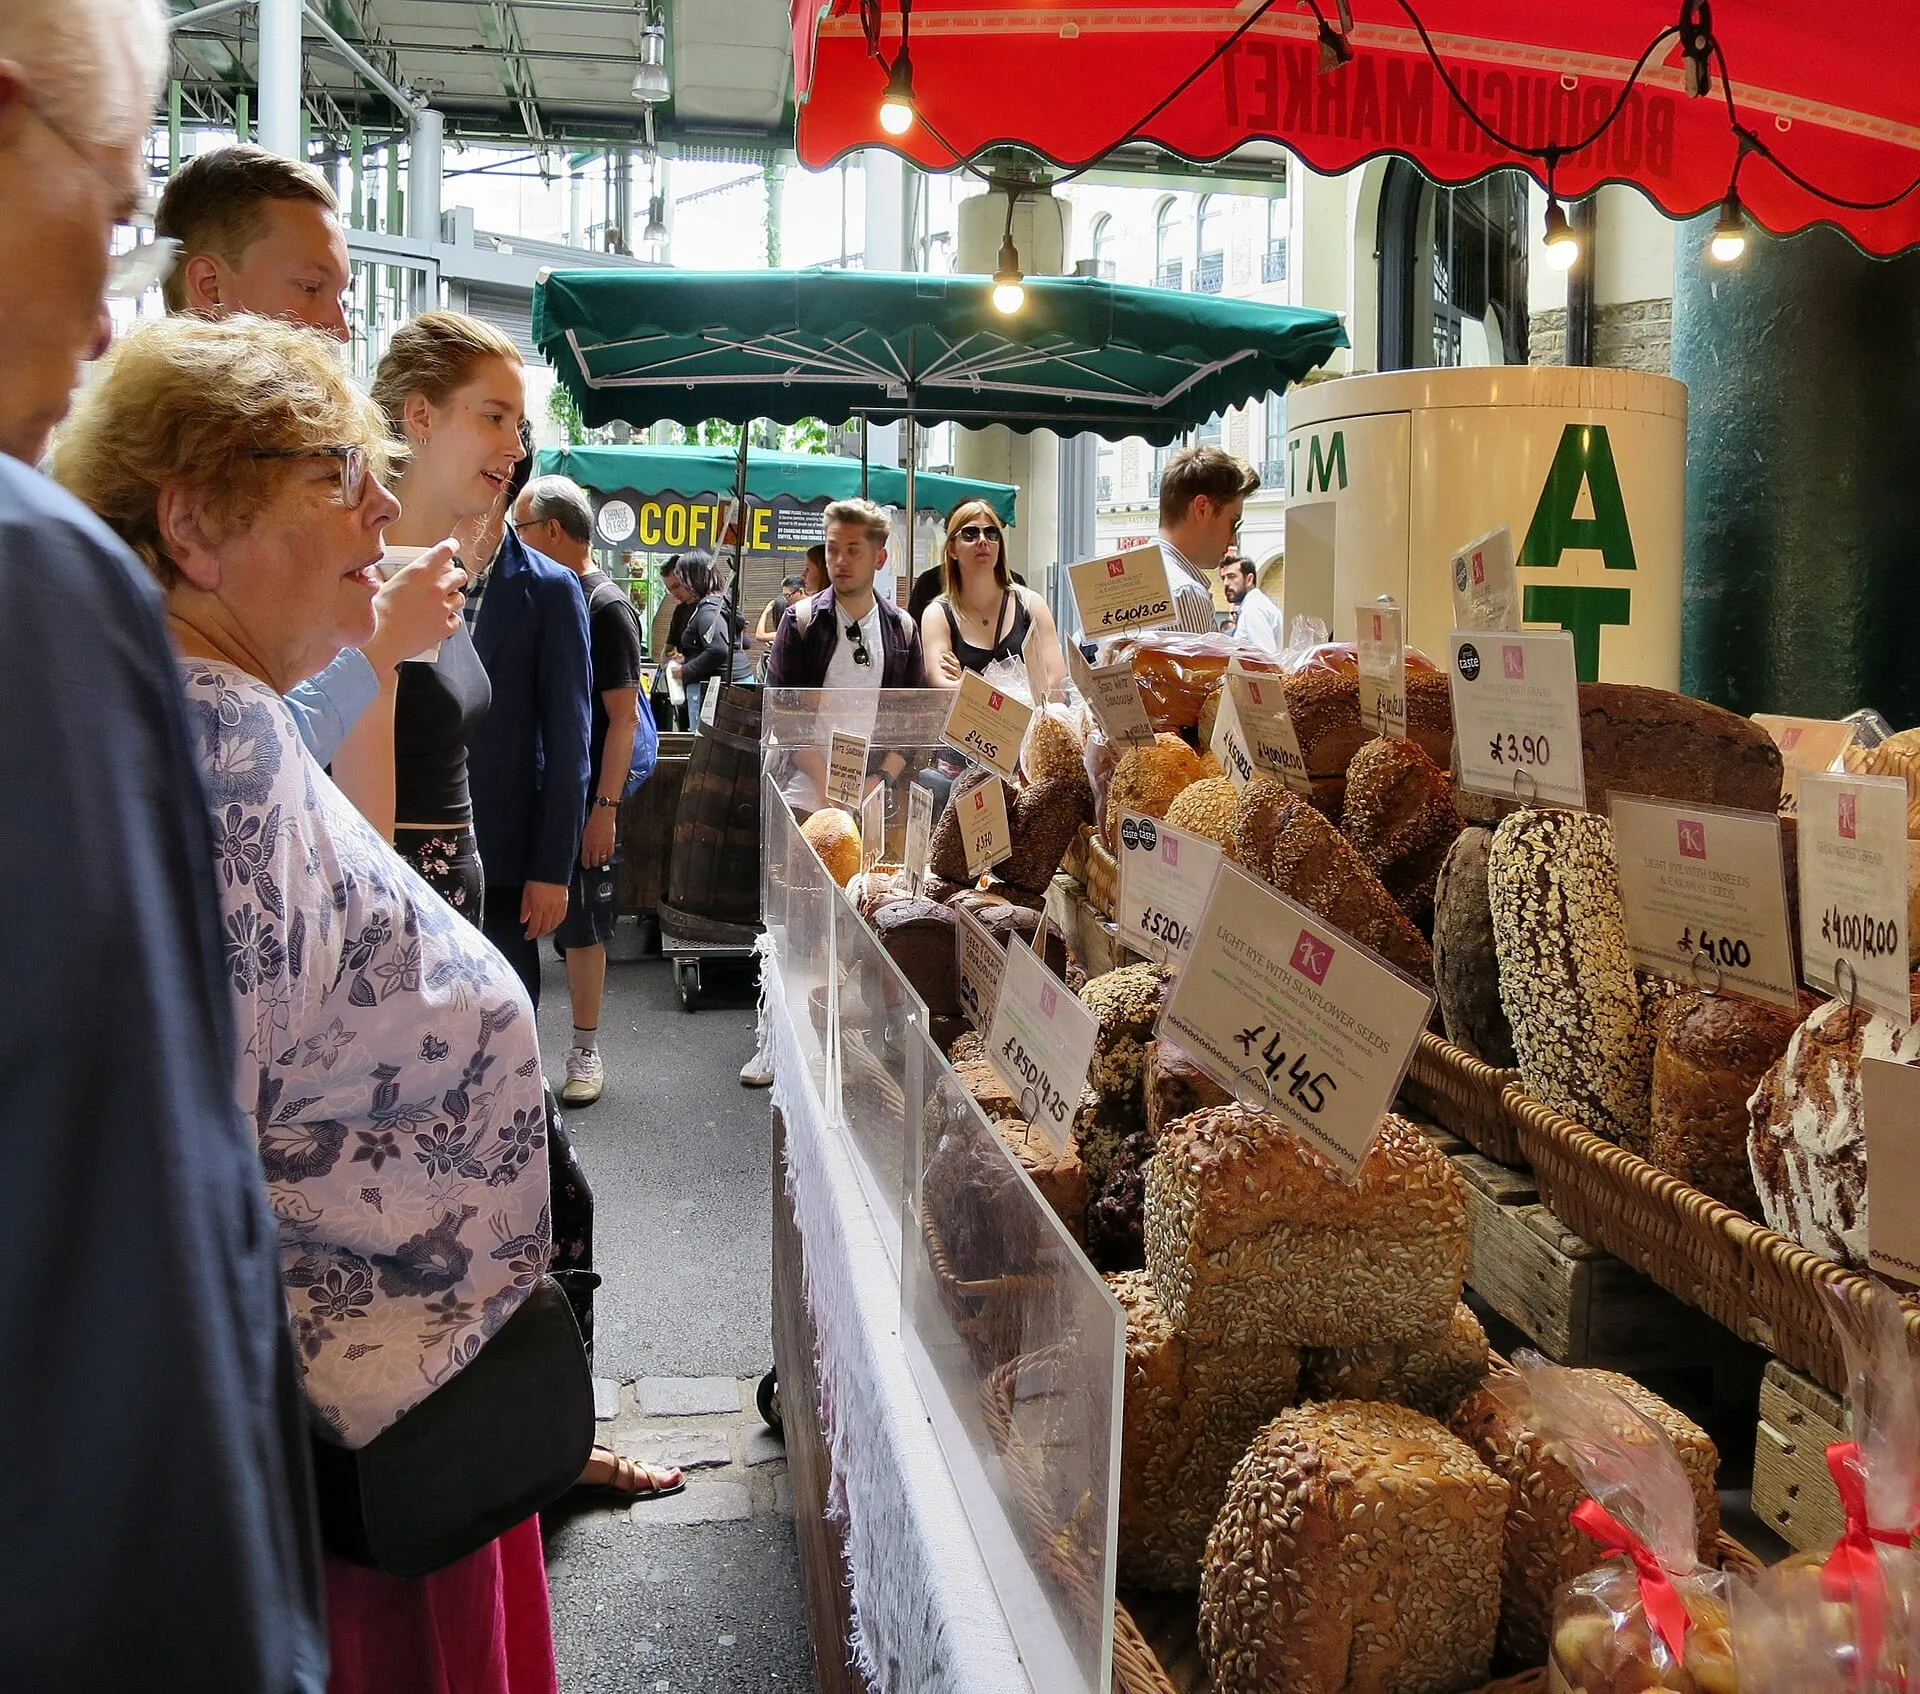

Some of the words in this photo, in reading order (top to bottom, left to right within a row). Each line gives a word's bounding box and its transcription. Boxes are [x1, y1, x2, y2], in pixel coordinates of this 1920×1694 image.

[639, 502, 772, 550] COFE
[1460, 658, 1479, 669] taste
[1490, 732, 1550, 767] £3.90
[1122, 829, 1138, 840] taste
[1139, 829, 1156, 842] taste
[1216, 926, 1247, 952] LIGHT
[1248, 946, 1271, 968] RYE
[1265, 956, 1293, 985] WITH
[1293, 978, 1355, 1029] SUNFLOWER
[1354, 1023, 1392, 1055] SEEDS
[1233, 1025, 1338, 1113] £4.45
